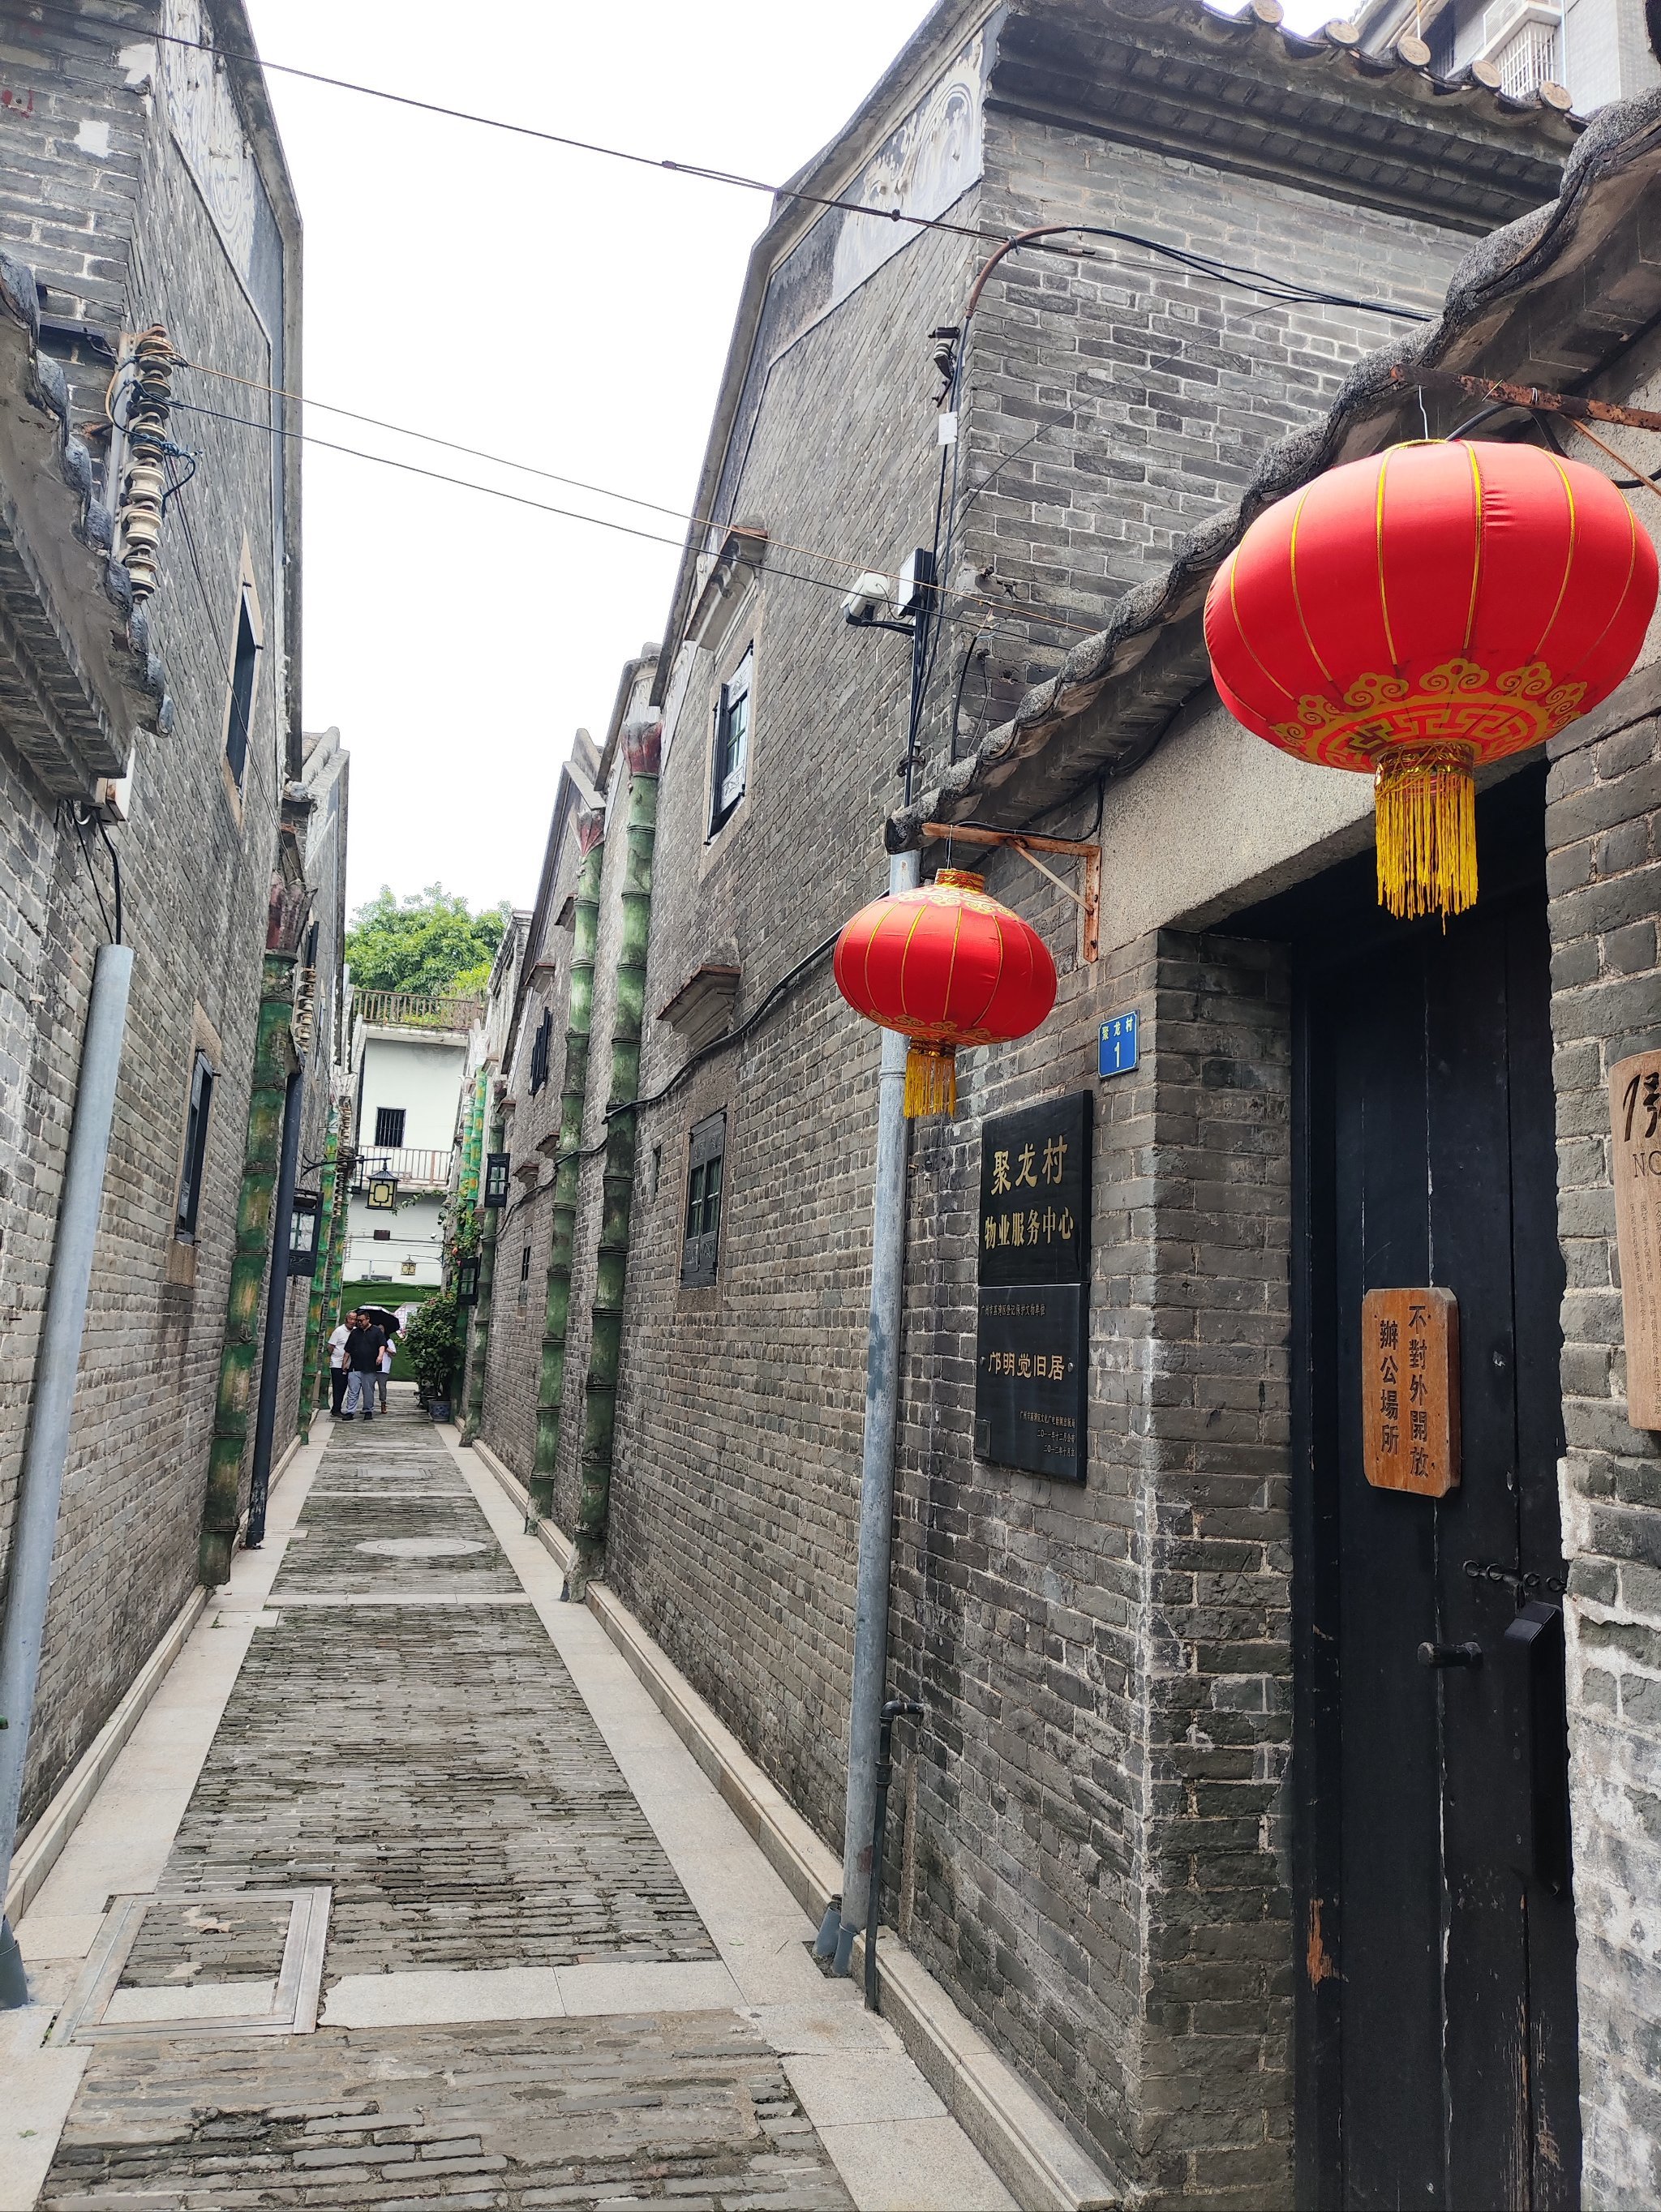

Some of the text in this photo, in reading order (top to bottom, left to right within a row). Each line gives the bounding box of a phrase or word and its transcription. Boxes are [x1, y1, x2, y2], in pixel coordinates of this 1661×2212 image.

[1102, 1016, 1133, 1040] 聚龙村
[1114, 1041, 1120, 1068] 1
[990, 1135, 1068, 1195] 聚龙村
[985, 1206, 1074, 1250] 物业服务中心
[989, 1352, 1065, 1381] 邝明觉旧居
[1380, 1319, 1399, 1455] 辦公場所
[1408, 1305, 1429, 1478] 不對外開放
